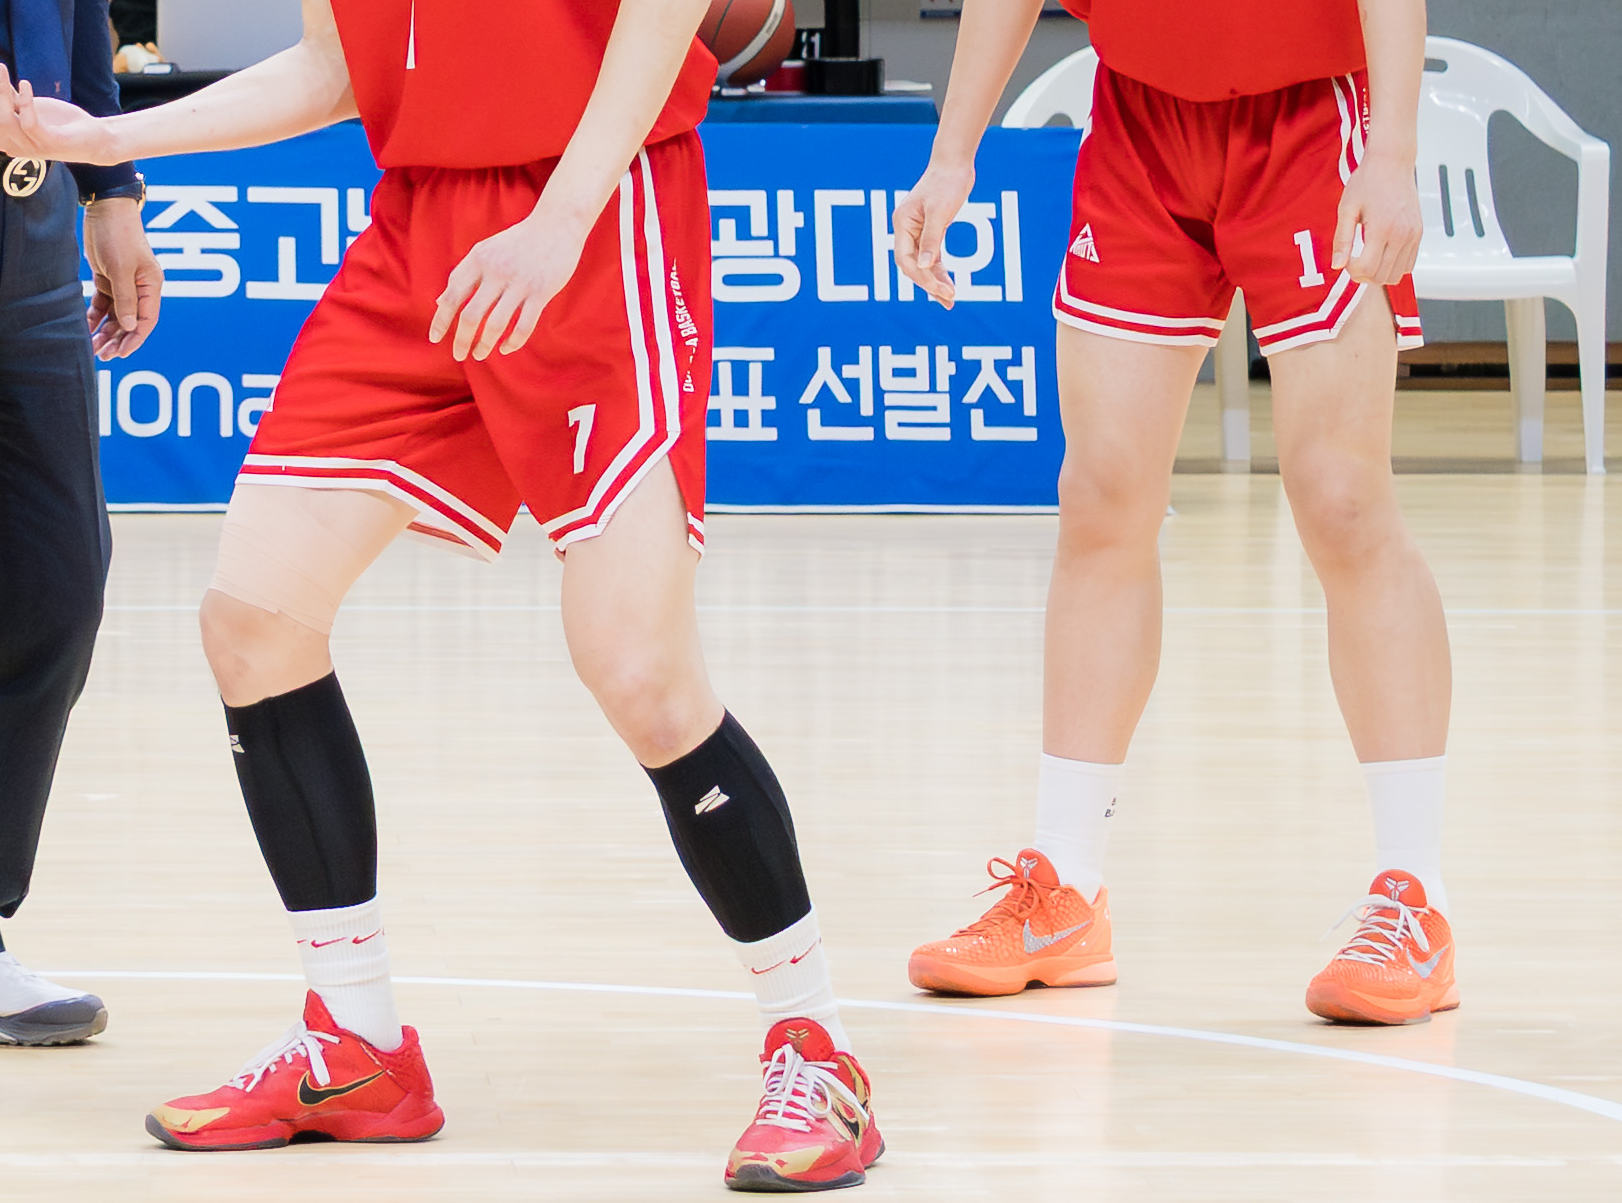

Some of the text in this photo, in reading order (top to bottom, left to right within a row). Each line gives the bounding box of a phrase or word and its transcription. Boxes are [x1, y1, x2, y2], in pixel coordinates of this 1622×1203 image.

[707, 188, 1024, 303] 광대회
[1292, 229, 1325, 289] 1
[706, 346, 779, 442] 표
[798, 344, 1039, 443] 선발전
[567, 402, 597, 475] 7
